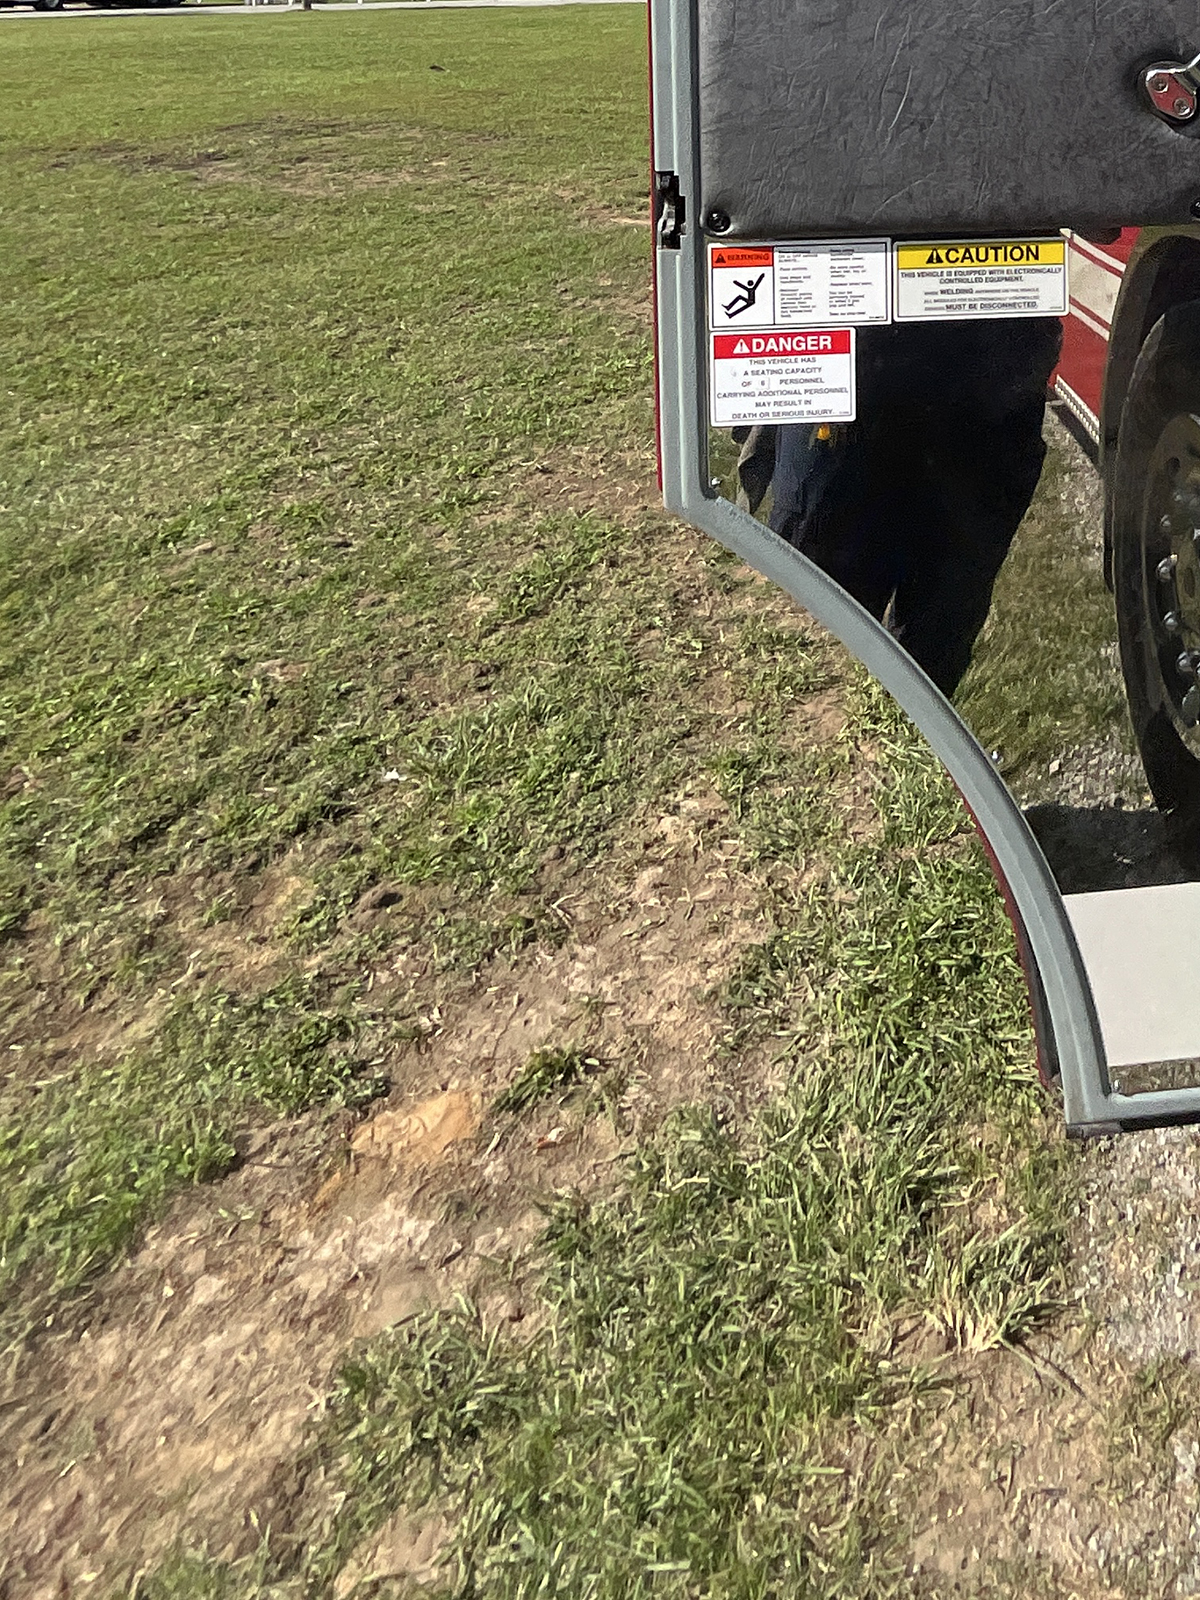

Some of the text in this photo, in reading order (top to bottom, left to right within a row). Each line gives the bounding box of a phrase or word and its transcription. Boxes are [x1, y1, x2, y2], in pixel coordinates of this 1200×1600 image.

[945, 245, 1039, 264] CAUTION
[954, 269, 987, 277] EQUIPPED
[1006, 267, 1062, 275] ELECTRONICALLY
[752, 335, 832, 353] DANGER
[717, 387, 848, 399] CARRYING ADDITIONAL PERSONNEL
